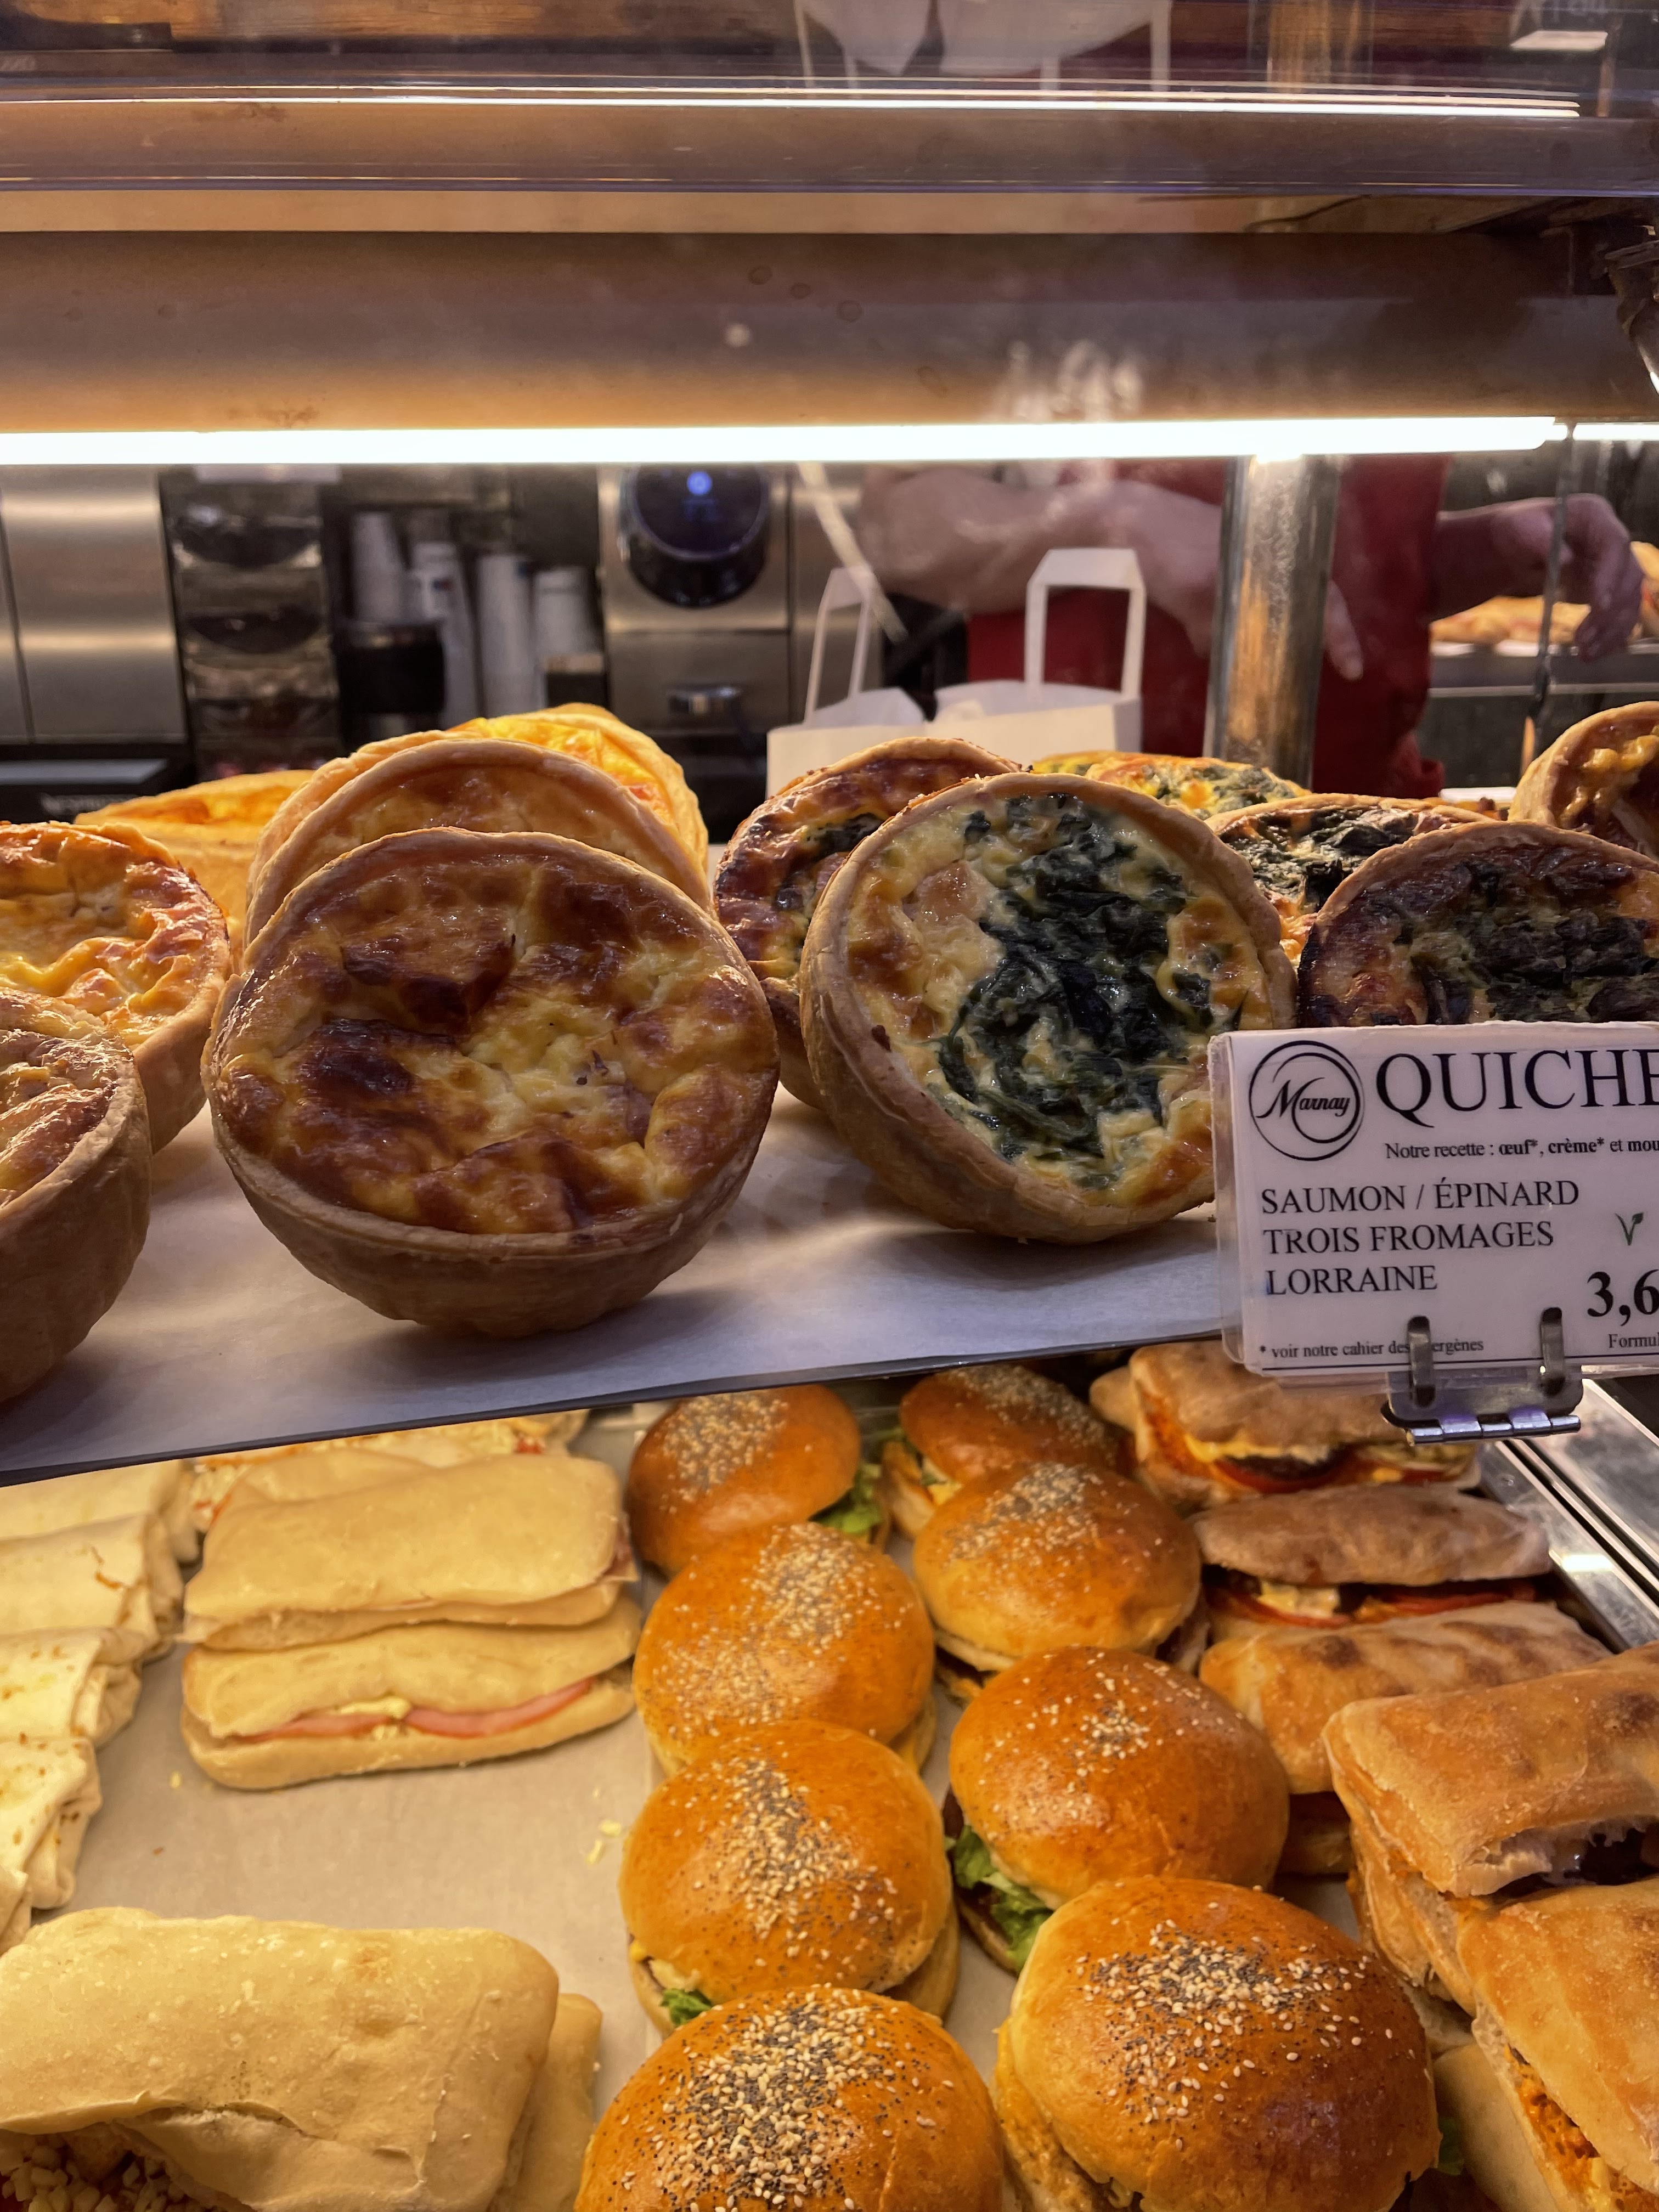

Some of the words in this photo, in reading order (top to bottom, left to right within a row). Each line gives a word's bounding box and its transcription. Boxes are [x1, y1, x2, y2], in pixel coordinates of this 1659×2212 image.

[1255, 1077, 1350, 1118] Marnay
[1385, 1143, 1430, 1159] Notre
[1434, 1143, 1485, 1158] recette
[1609, 1139, 1624, 1152] et
[1261, 1185, 1407, 1214] SAUMON
[1433, 1177, 1579, 1209] ÉPINARD
[1263, 1227, 1361, 1254] TROIS
[1369, 1221, 1554, 1251] FROMAGES
[1266, 1265, 1438, 1295] LORRAINE
[1271, 1344, 1299, 1358] voir
[1303, 1345, 1339, 1357] notre
[1342, 1341, 1385, 1356] cahier
[1388, 1340, 1410, 1354] des
